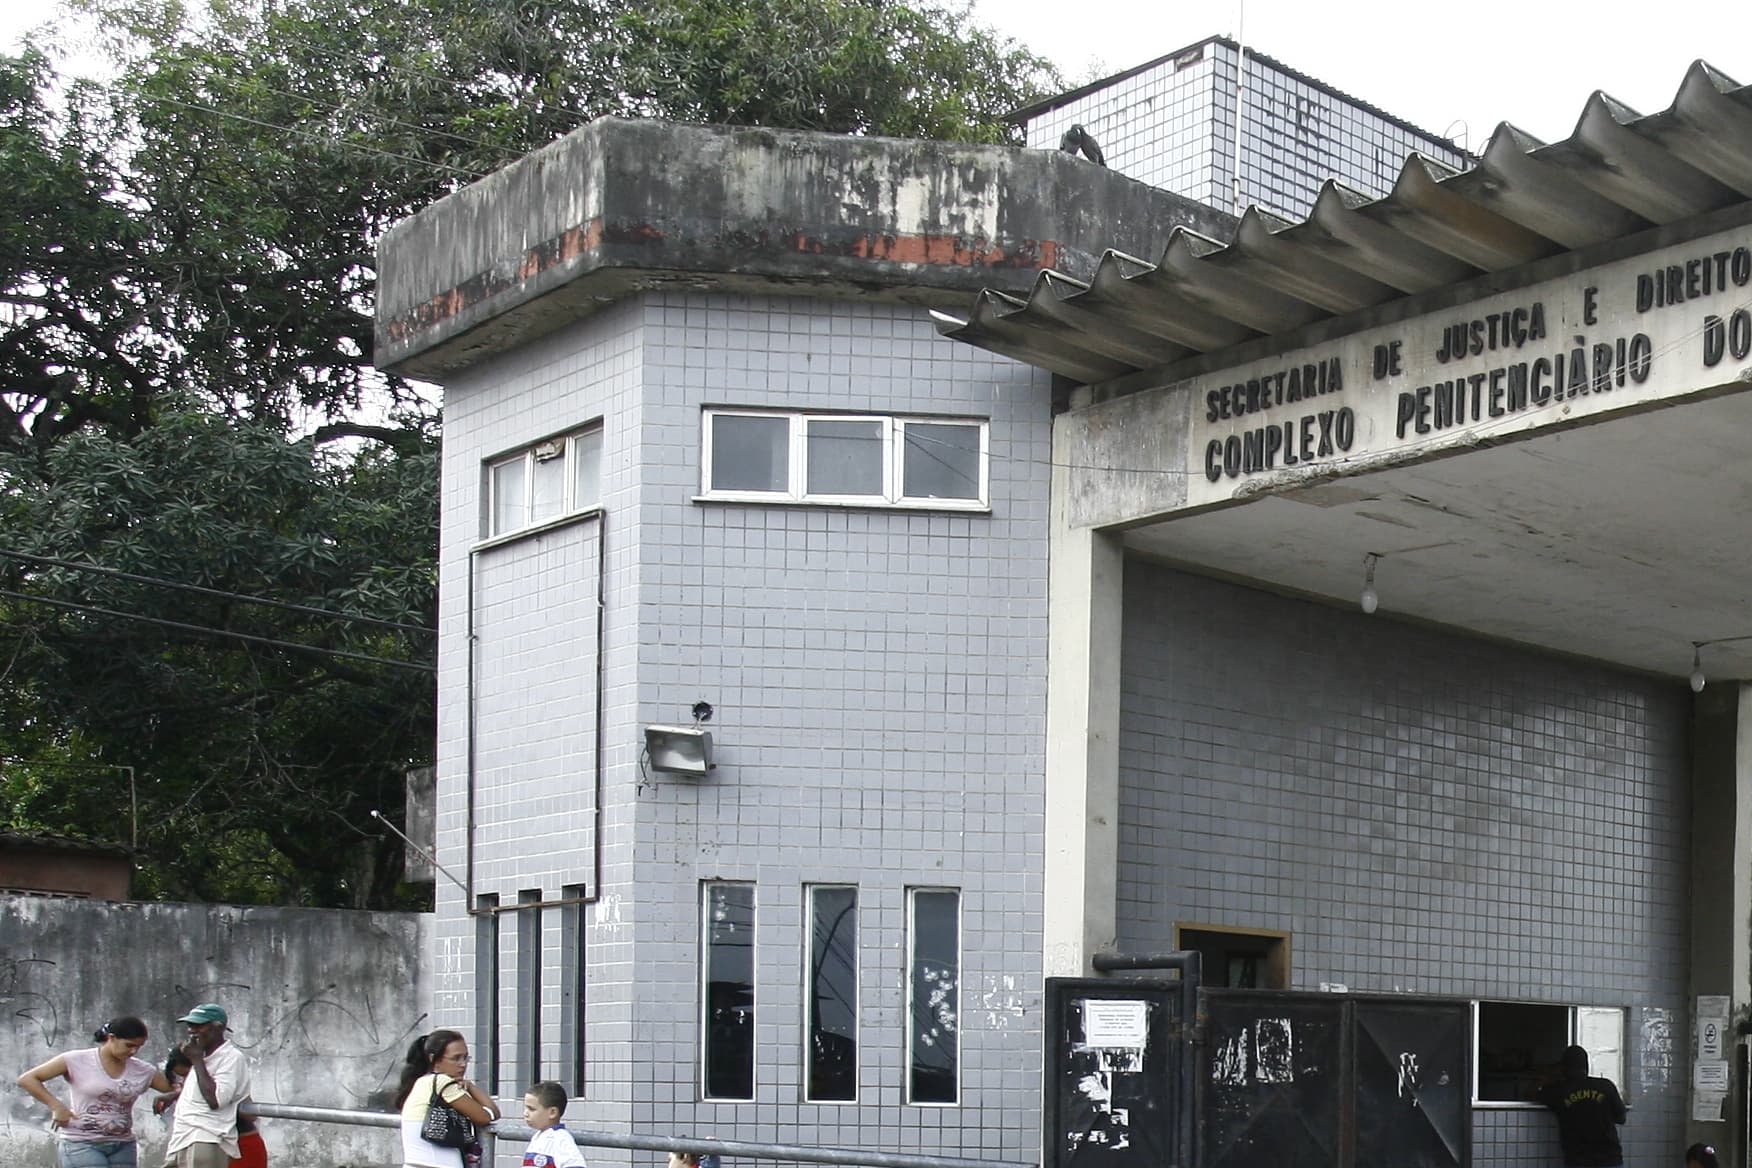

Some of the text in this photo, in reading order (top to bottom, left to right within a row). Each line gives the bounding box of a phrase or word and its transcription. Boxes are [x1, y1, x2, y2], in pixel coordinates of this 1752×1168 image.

[1204, 406, 1356, 483] COMPLEXO
[1703, 307, 1752, 368] DO
[1205, 356, 1343, 424] SECRETARIA
[1373, 340, 1403, 381] DE
[1436, 301, 1547, 364] JUSTIÇA
[1583, 285, 1600, 327] E
